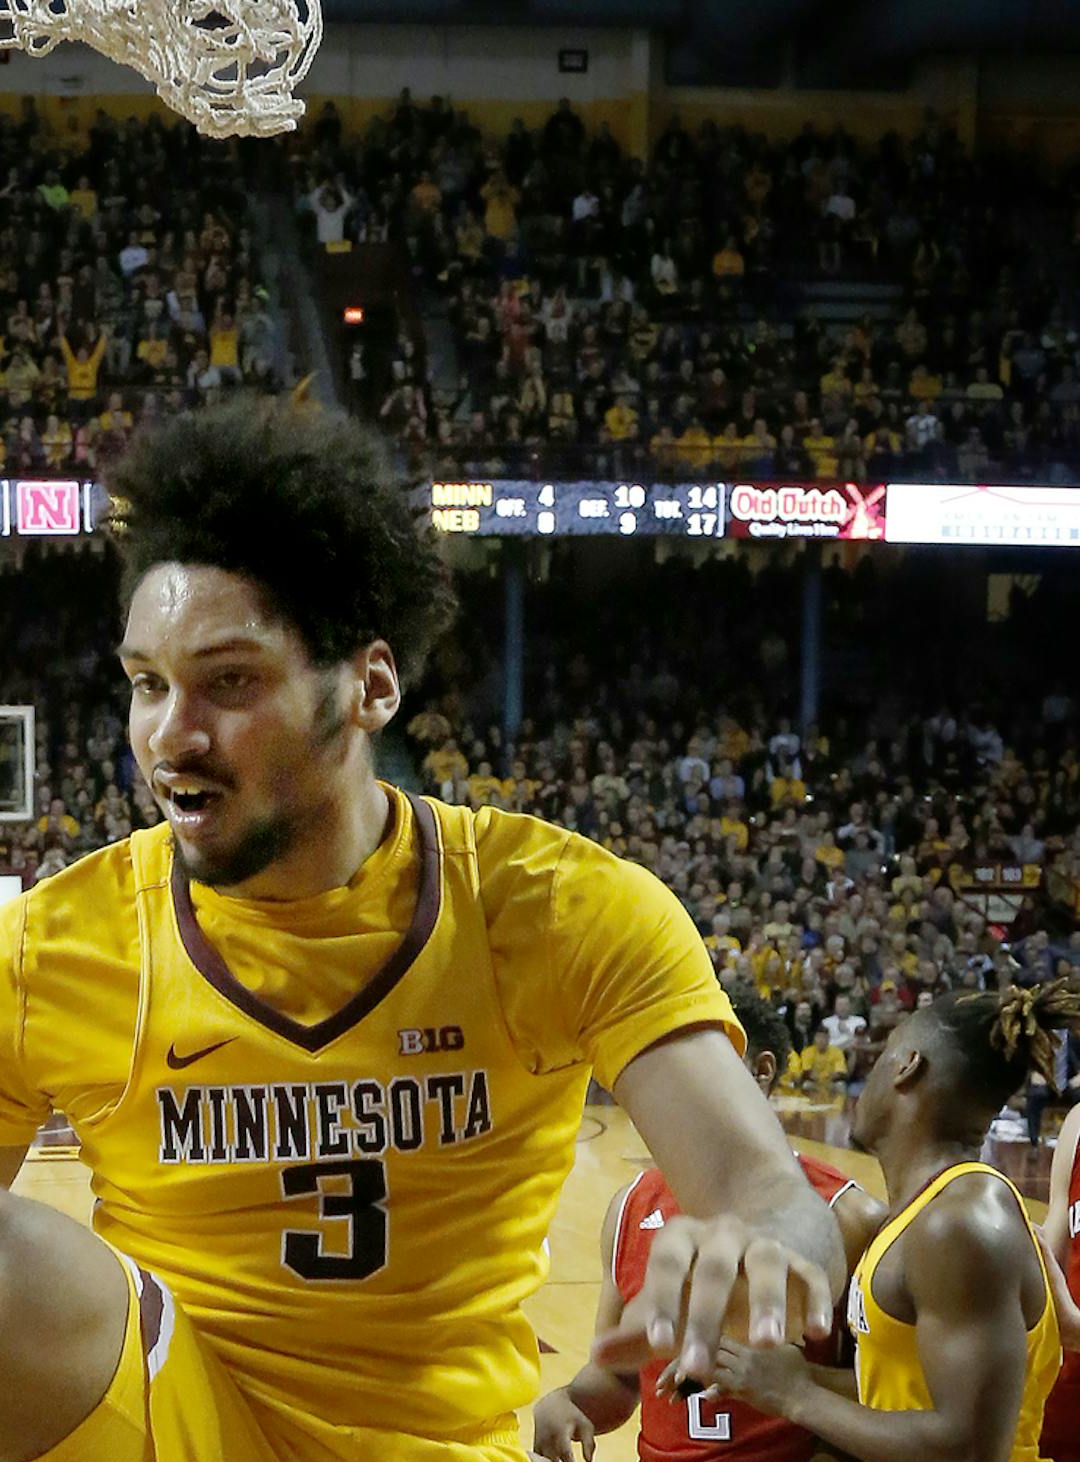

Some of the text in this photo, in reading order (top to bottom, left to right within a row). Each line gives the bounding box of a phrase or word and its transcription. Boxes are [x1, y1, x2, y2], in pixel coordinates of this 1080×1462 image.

[432, 483, 555, 507] MINN 4
[687, 486, 717, 509] 14
[737, 492, 841, 515] Old Dutch
[24, 488, 74, 530] N
[432, 509, 480, 533] NEB
[687, 513, 717, 536] 17
[155, 1068, 493, 1164] MINNESOTA
[280, 1159, 390, 1285] 3
